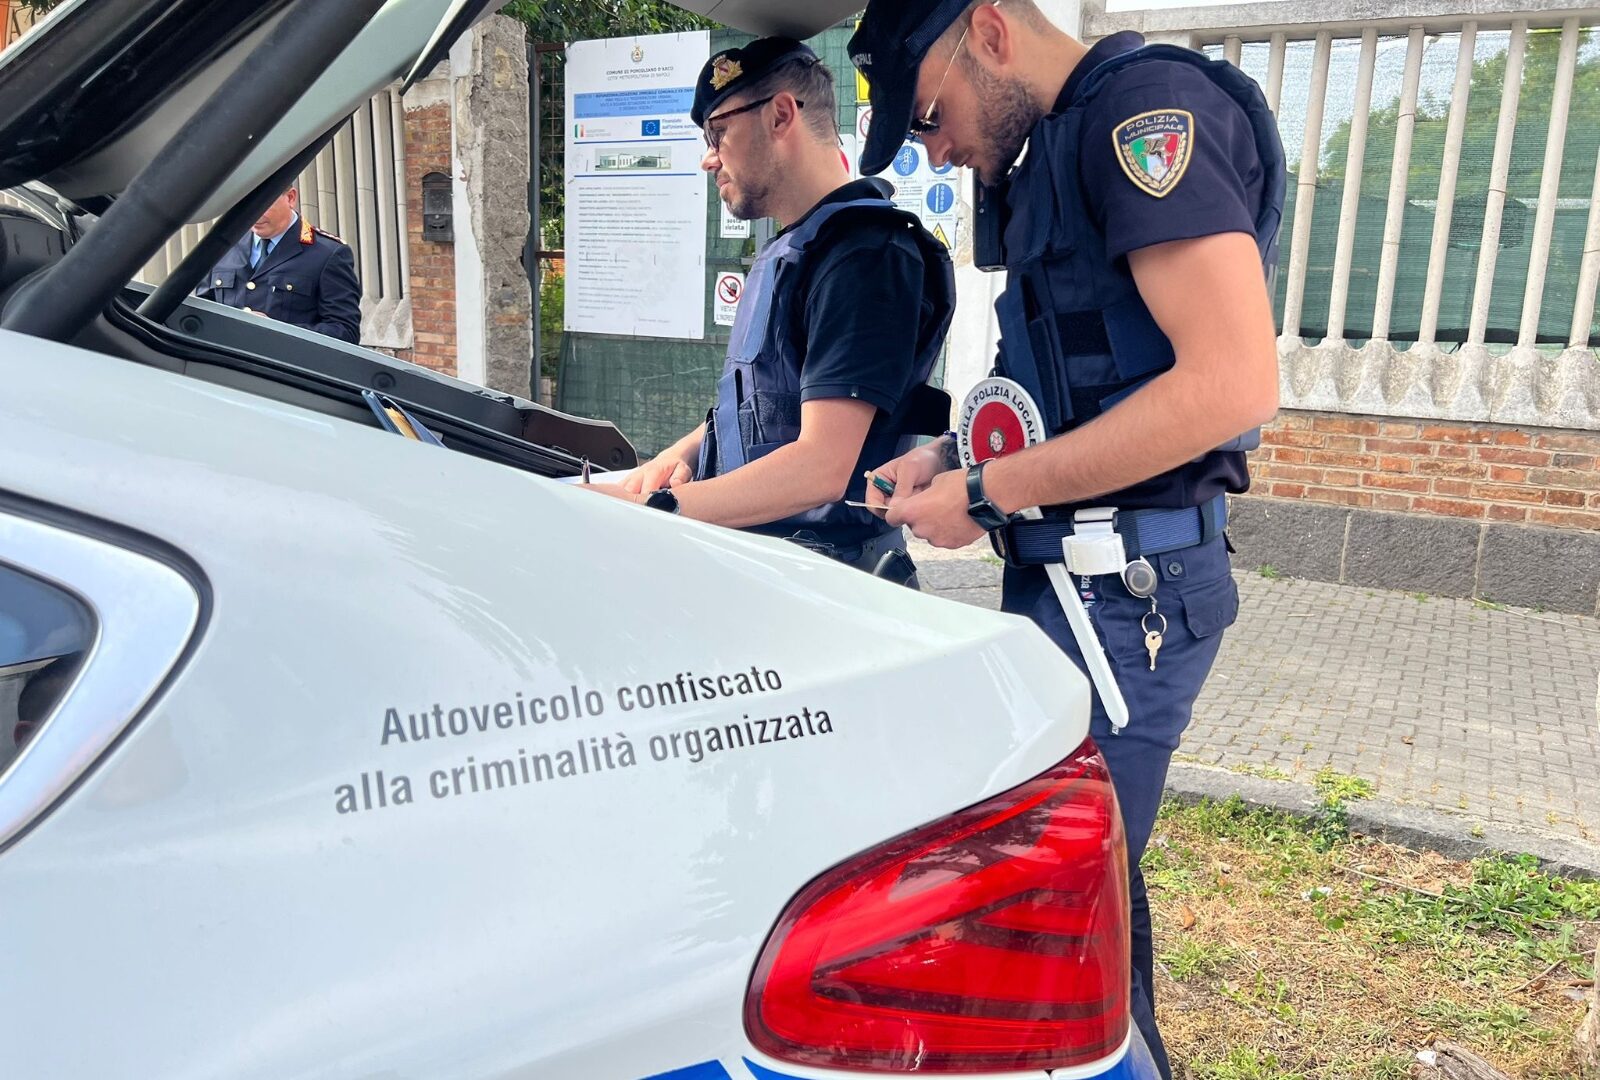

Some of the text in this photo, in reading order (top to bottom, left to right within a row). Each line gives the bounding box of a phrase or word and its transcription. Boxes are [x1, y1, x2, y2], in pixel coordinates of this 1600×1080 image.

[1124, 124, 1184, 141] MUNICIPALE
[1126, 115, 1179, 132] POLIZIA
[962, 386, 1037, 446] DELLA POLIZIA LOCALE
[381, 665, 783, 745] Autoveicolo confiscato
[334, 706, 834, 815] alla criminalità organizzata
